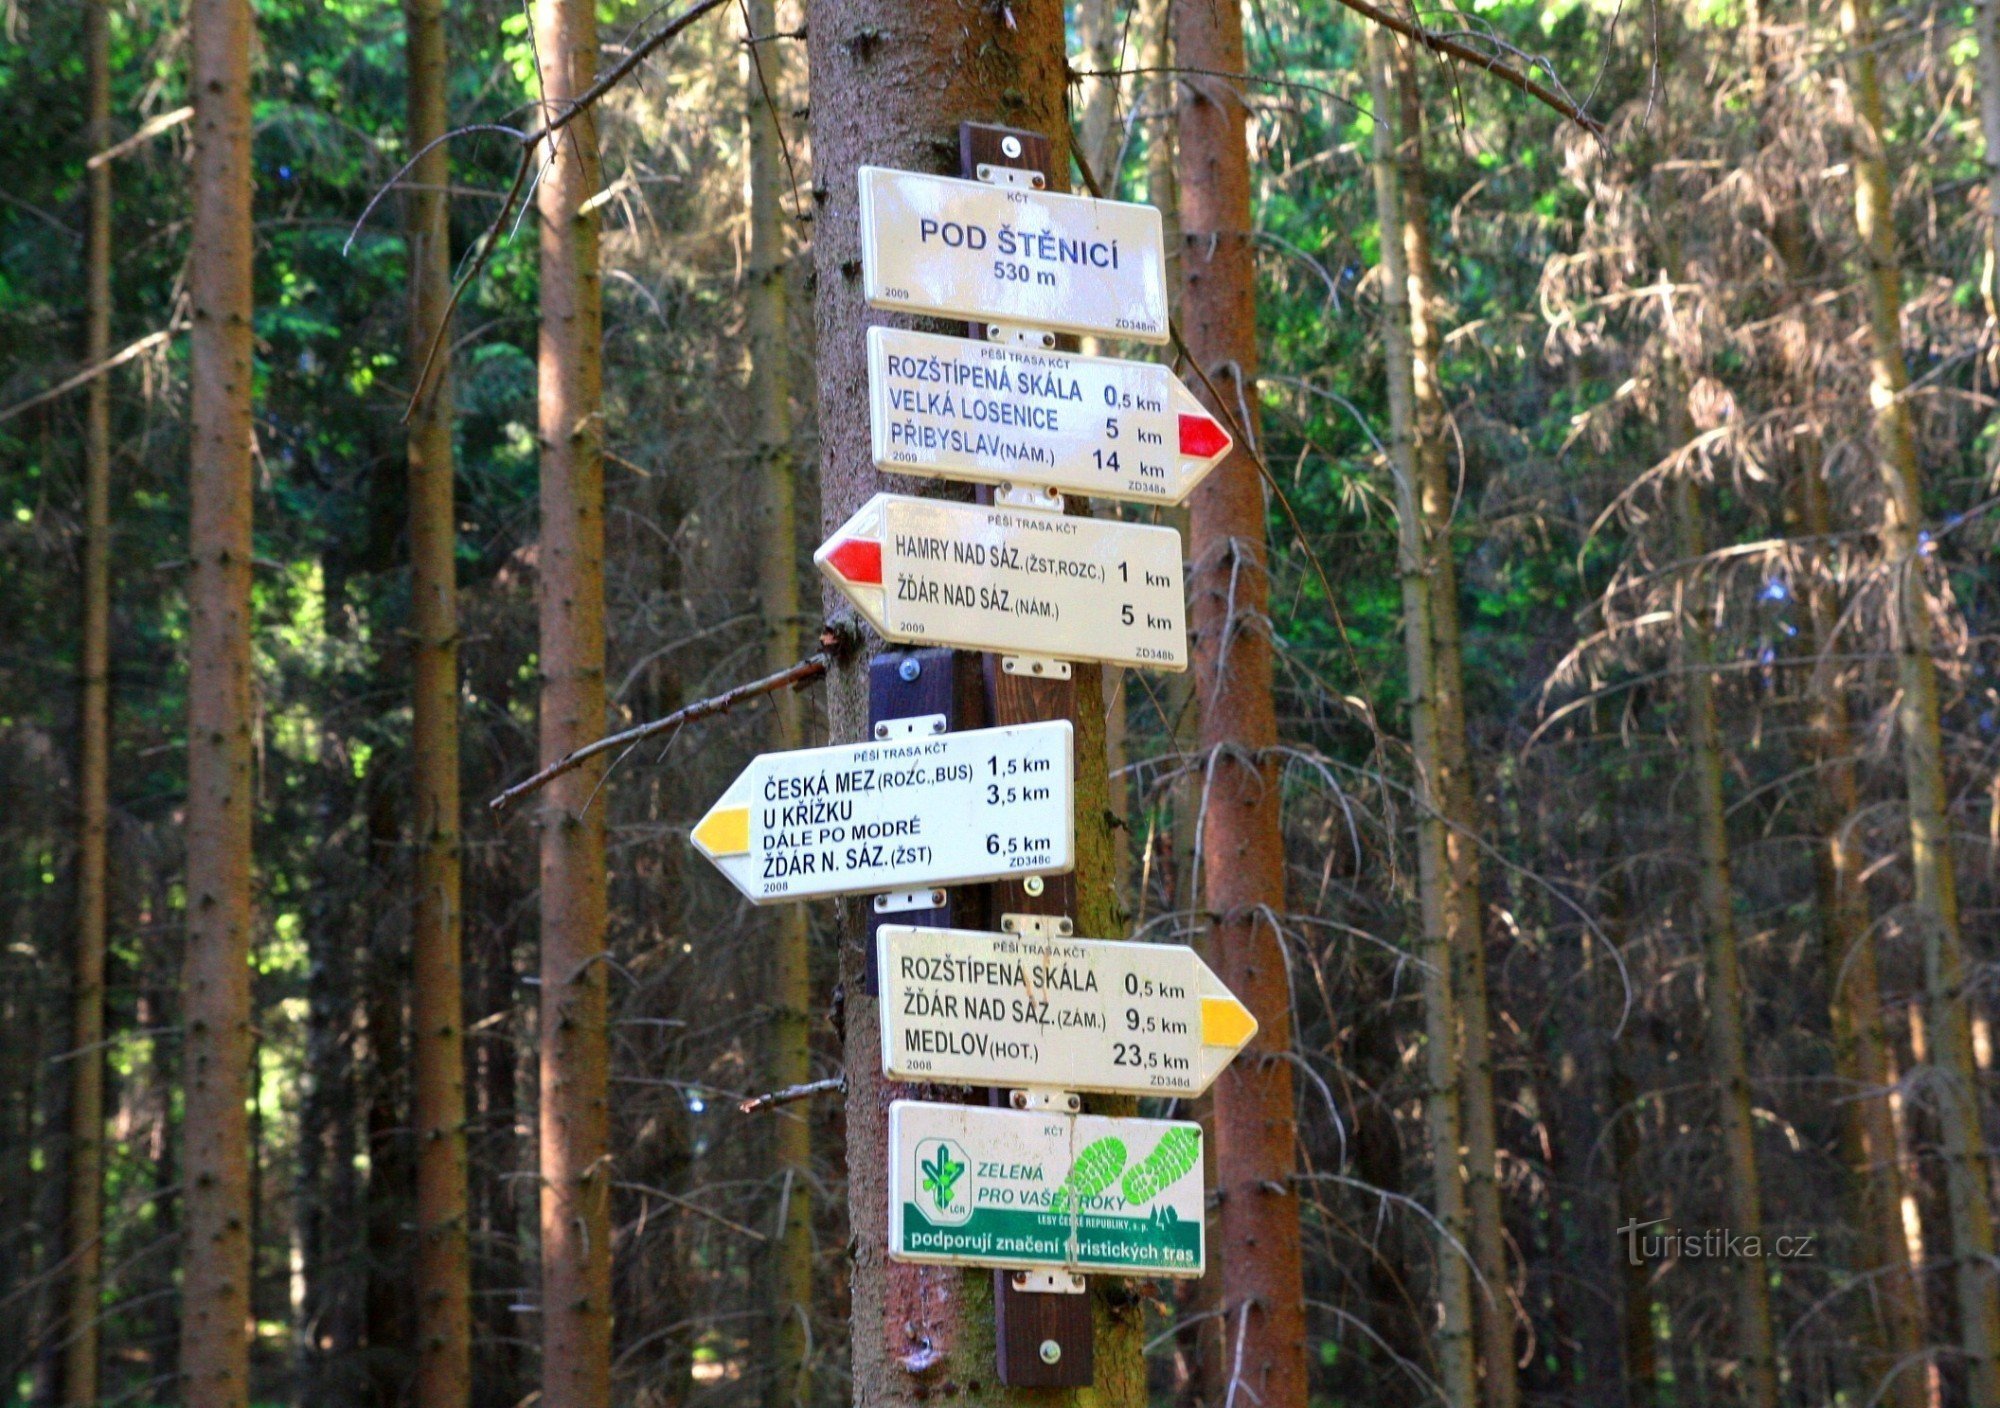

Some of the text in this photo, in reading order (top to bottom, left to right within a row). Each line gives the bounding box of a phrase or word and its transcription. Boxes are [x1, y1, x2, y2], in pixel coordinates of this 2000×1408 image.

[1007, 191, 1028, 204] KČT
[920, 219, 1118, 269] POD ŠTĚNICÍ
[994, 262, 1056, 285] 530 m
[885, 288, 909, 299] 2009
[1009, 352, 1046, 366] TRASA
[1049, 358, 1071, 369] KČT
[888, 355, 1161, 412] ROZŠTÍPENÁ SKÁLA 0,5 km
[889, 388, 1162, 445] VELKÁ LOSENICE 5 km
[893, 452, 917, 463] 2009
[1093, 450, 1120, 472] 14
[1140, 462, 1164, 478] km
[1128, 481, 1166, 495] ZD348a
[1017, 517, 1053, 533] TRASA
[1056, 522, 1077, 535] KČT
[896, 535, 950, 562] HAMRY
[954, 543, 986, 564] NAD
[1118, 562, 1129, 583] 1
[1146, 572, 1170, 588] km
[898, 574, 938, 602] ŽĎÁR
[944, 585, 976, 606] NAD
[1121, 605, 1134, 625] 5
[1147, 614, 1172, 630] km
[900, 622, 925, 633] 2009
[1136, 647, 1174, 661] ZD348b
[883, 745, 922, 759] TRASA
[925, 743, 947, 755] KČT
[764, 770, 829, 801] ČESKÁ
[987, 755, 1018, 778] 1,5
[1023, 757, 1050, 772] km
[764, 784, 1049, 829] U KŘÍŽKU 3,5 km
[764, 815, 921, 850] DÁLE PO MODRÉ
[764, 851, 815, 878] ŽĎÁR
[822, 853, 839, 871] N.
[986, 834, 1018, 856] 6,5
[1024, 836, 1051, 851] km
[1009, 855, 1051, 868] ZD348c
[764, 882, 788, 892] 2008
[1022, 945, 1060, 958] TRASA
[1063, 947, 1086, 959] KČT
[902, 955, 1185, 998] ROZŠTÍPENÁ SKÁLA 0,5 km
[904, 987, 957, 1018] ŽĎÁR
[965, 998, 1005, 1021] NAD
[1126, 1009, 1156, 1032] 9,5
[1162, 1019, 1187, 1034] km
[907, 1060, 932, 1071] 2008
[1113, 1043, 1157, 1069] 23,5
[1163, 1054, 1189, 1070] km
[1150, 1076, 1190, 1088] ZD348d
[1044, 1125, 1063, 1136] KČT
[977, 1162, 1044, 1181] ZELENÁ
[978, 1189, 1013, 1204] PRO
[1020, 1189, 1060, 1207] VAŠE
[1038, 1214, 1057, 1226] LESY
[911, 1230, 992, 1250] podporují
[997, 1235, 1058, 1254] značení
[1164, 1245, 1193, 1262] tras
